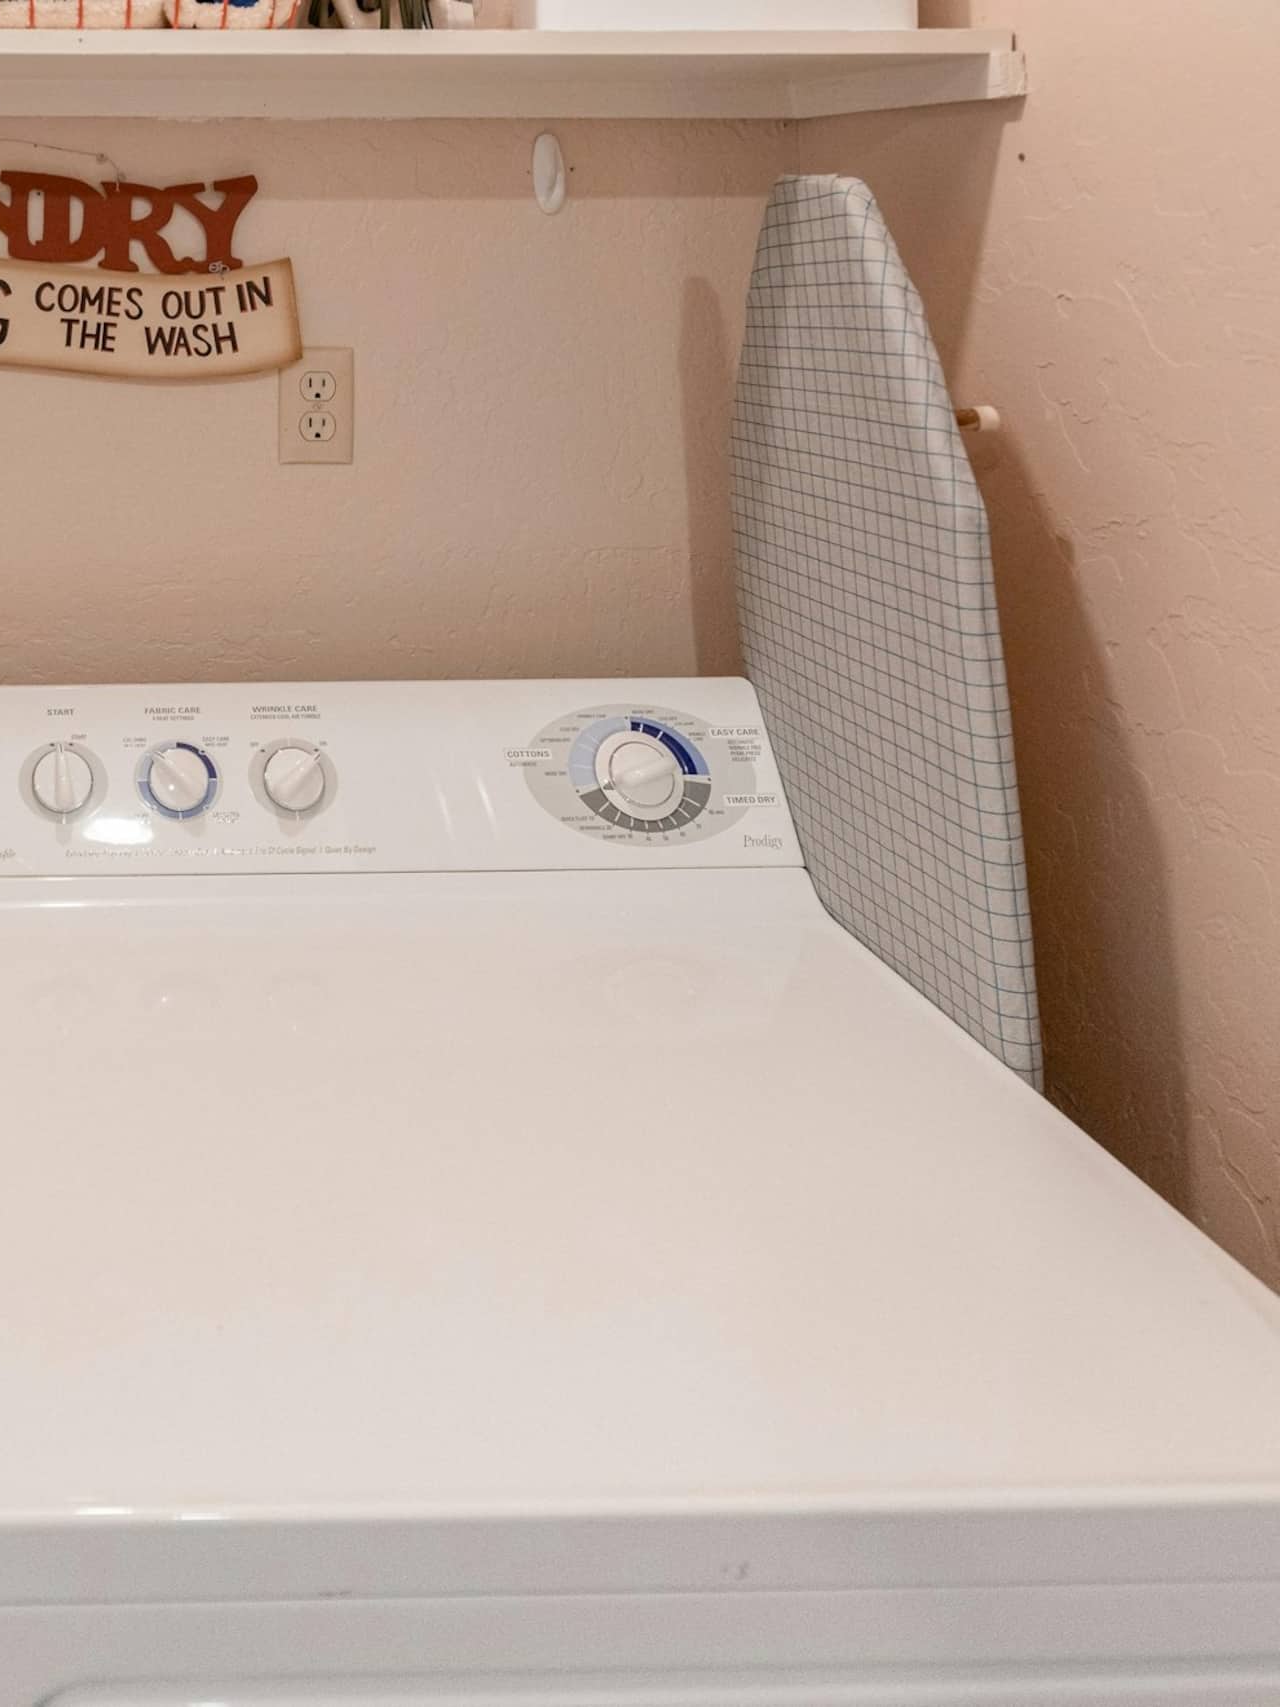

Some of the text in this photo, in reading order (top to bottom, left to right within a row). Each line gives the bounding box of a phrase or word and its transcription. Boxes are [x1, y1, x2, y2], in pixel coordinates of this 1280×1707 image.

[34, 276, 275, 321] COMES OUT IN
[60, 317, 239, 357] THE WASH
[47, 708, 75, 717] START
[144, 706, 201, 715] FABRIC CARE
[251, 704, 318, 714] WRINKLE CARE
[710, 728, 759, 736] EASY CARE
[507, 750, 551, 759] COTTONS
[726, 796, 776, 804] TIMED DRY
[743, 834, 783, 849] Prodigy
